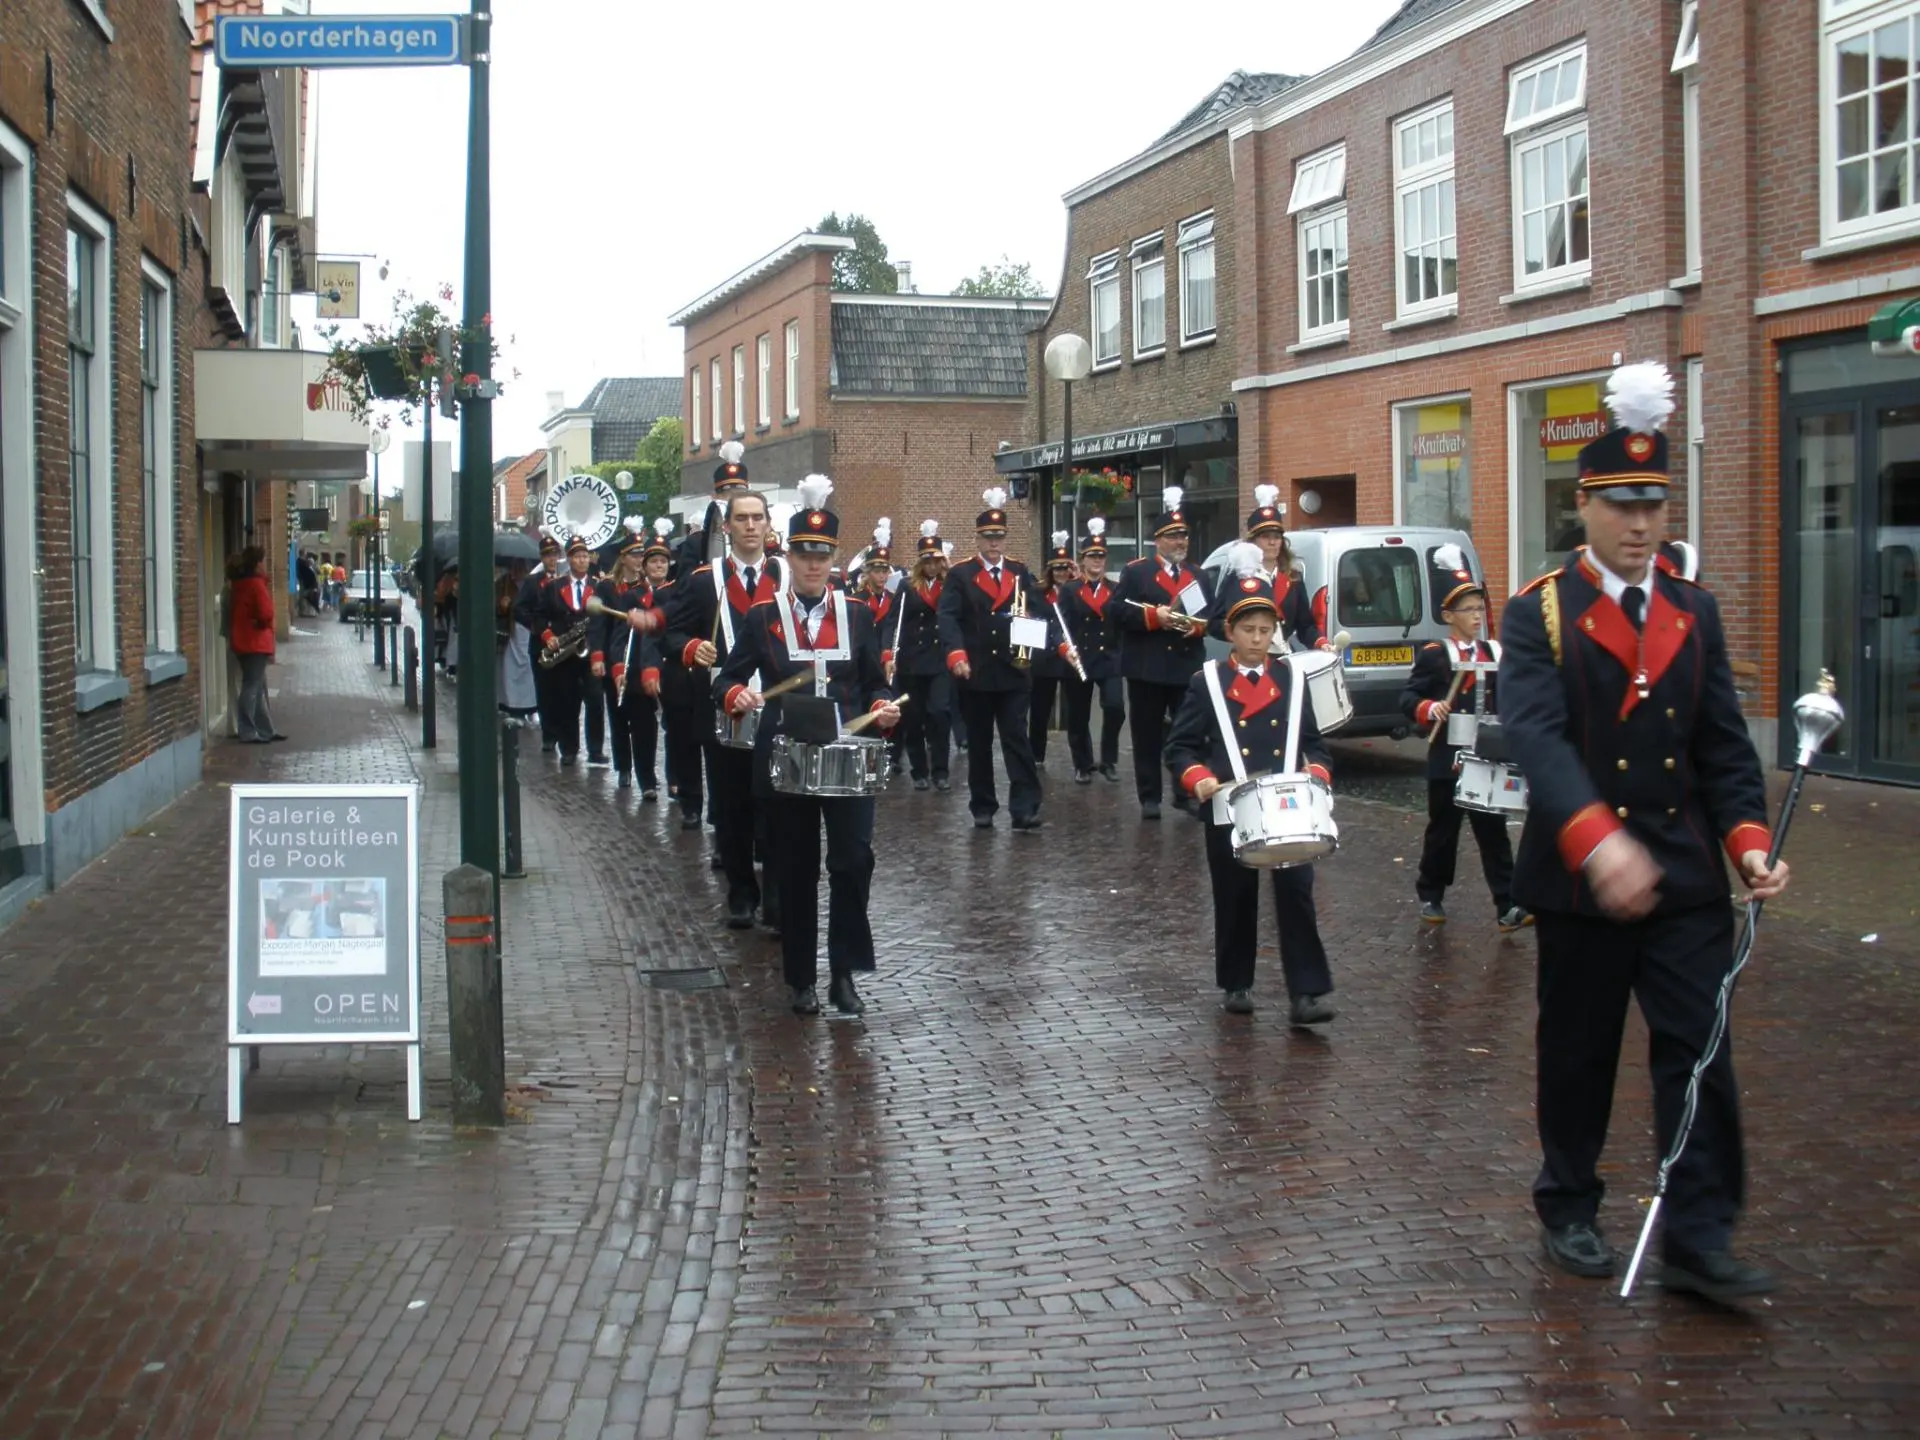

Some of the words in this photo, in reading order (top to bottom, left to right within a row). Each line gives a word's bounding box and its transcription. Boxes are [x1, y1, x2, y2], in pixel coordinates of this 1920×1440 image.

[240, 25, 437, 52] Noorderhagen
[337, 279, 354, 287] Vin
[1546, 418, 1599, 441] Kruidvat
[1417, 434, 1461, 455] Kruidvat
[545, 476, 617, 537] DRUMFANFARE
[1355, 650, 1407, 662] 68-BJ-LV
[249, 806, 335, 824] Galerie
[346, 806, 361, 824] &
[248, 828, 398, 847] Kunstuitleen
[248, 850, 276, 867] de
[287, 850, 346, 867] Pook
[314, 993, 399, 1014] OPEN
